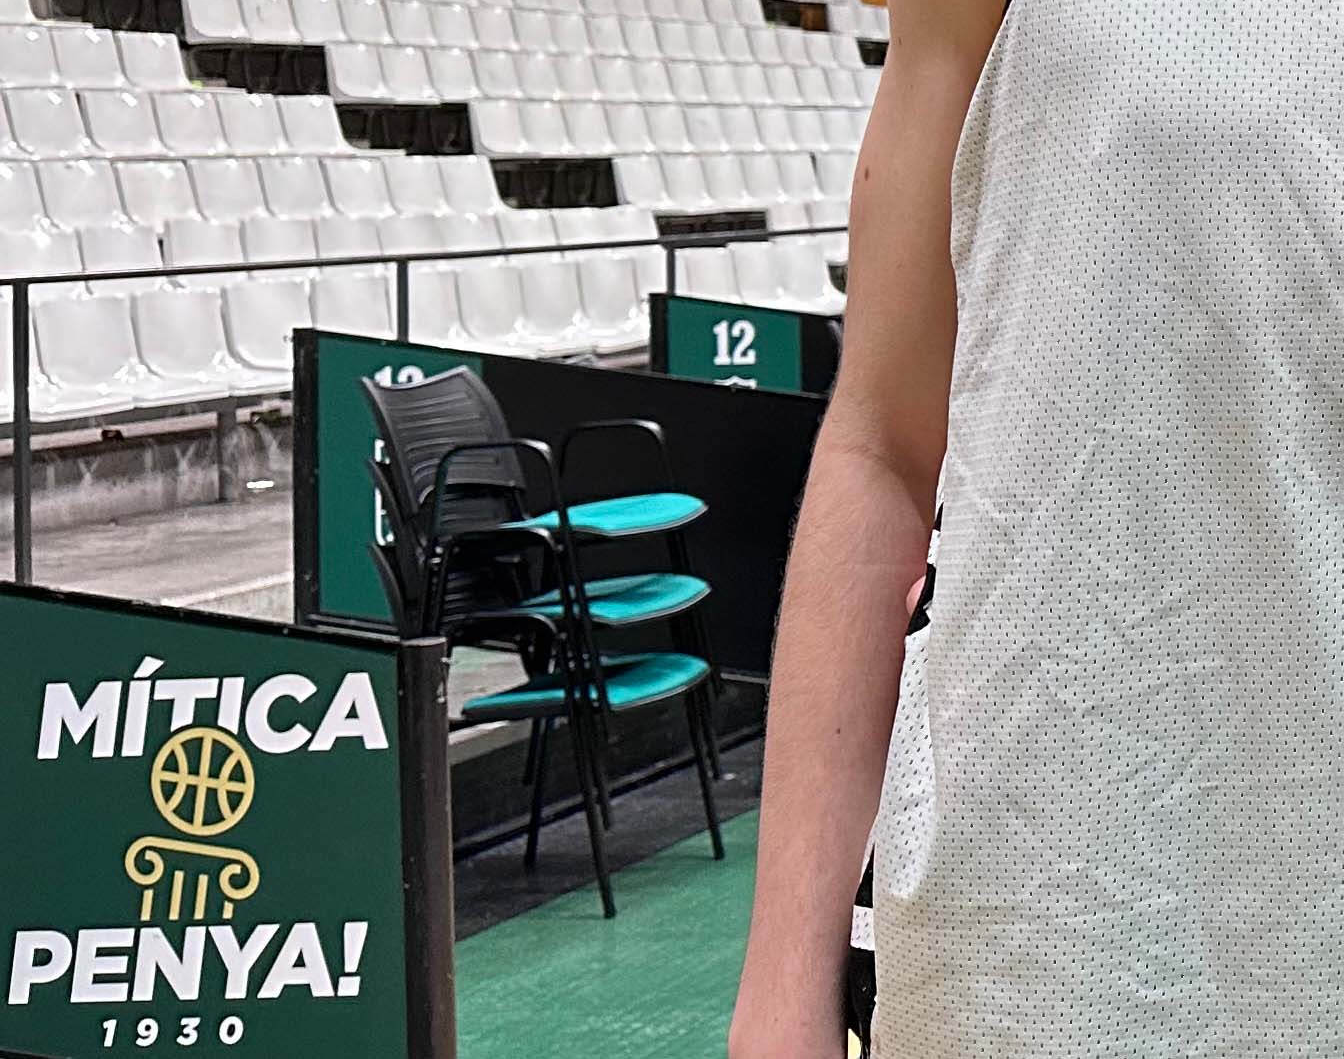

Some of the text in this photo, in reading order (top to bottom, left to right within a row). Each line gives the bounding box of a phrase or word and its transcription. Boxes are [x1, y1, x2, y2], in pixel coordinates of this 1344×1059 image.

[712, 319, 757, 366] 12
[36, 656, 390, 761] MÍTICA
[7, 921, 369, 1005] PENYA!
[102, 1015, 245, 1047] 1930
